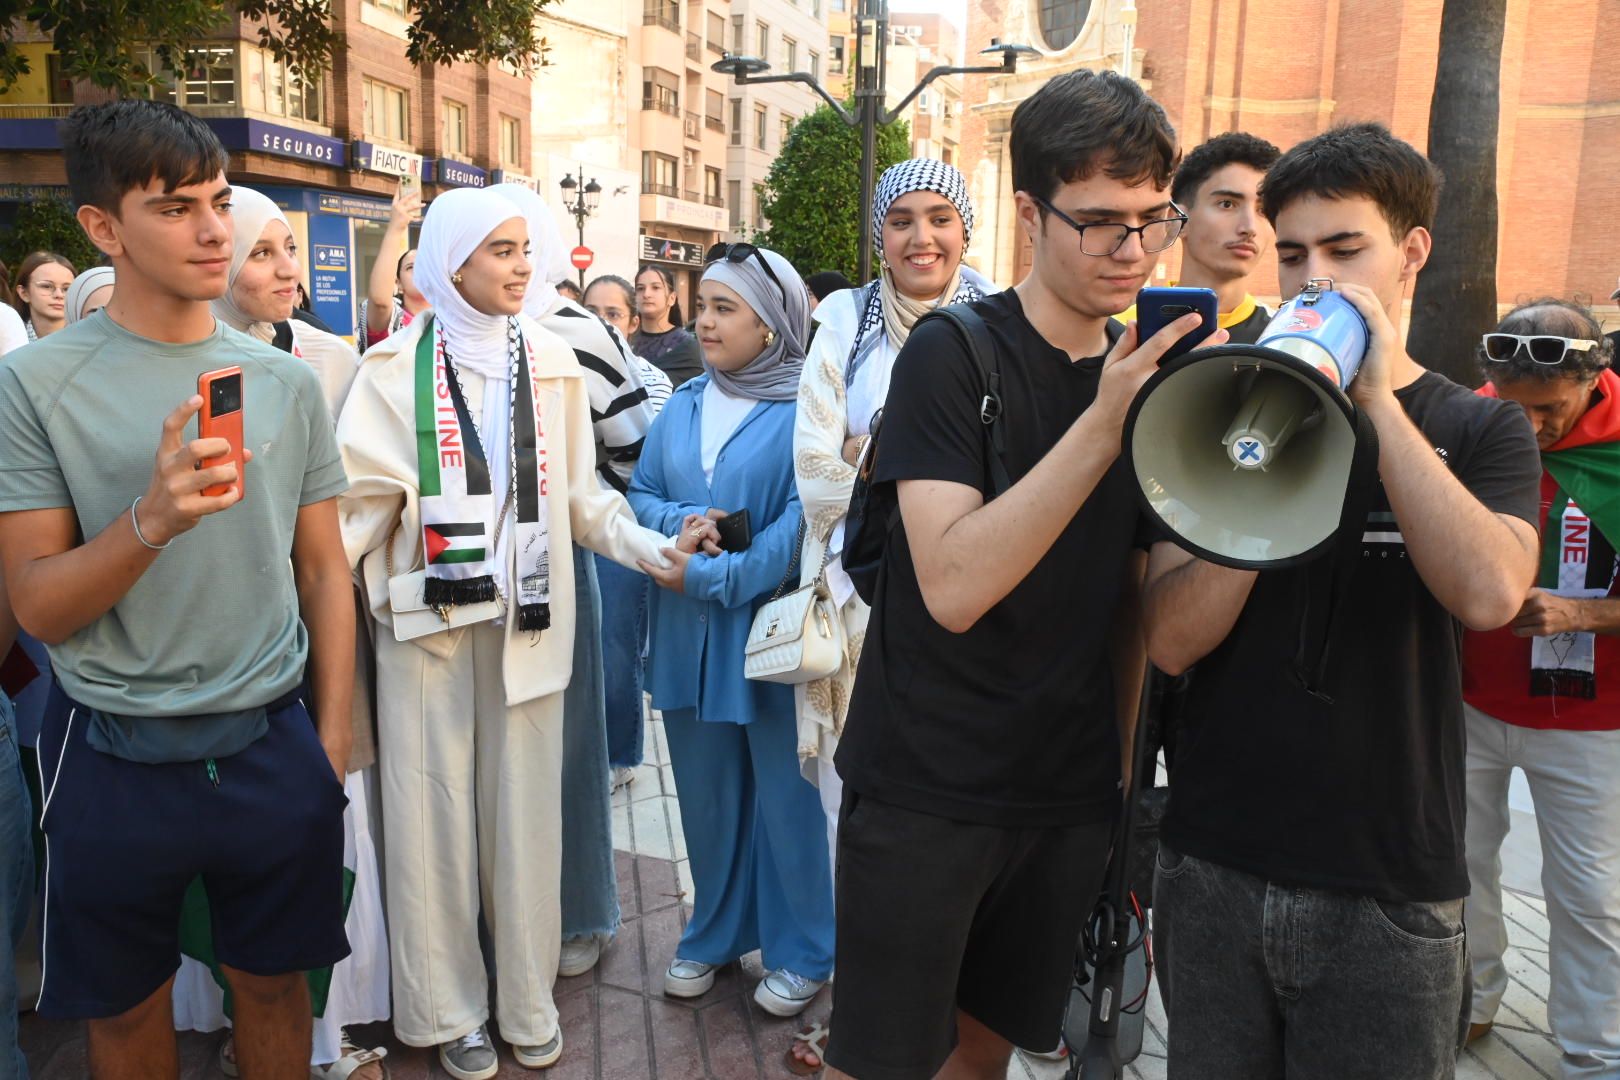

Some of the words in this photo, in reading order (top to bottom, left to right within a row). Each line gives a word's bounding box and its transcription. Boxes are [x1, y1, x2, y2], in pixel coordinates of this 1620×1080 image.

[262, 133, 333, 160] SEGUROS
[375, 149, 407, 172] FIATC
[445, 168, 485, 188] SEGUROS
